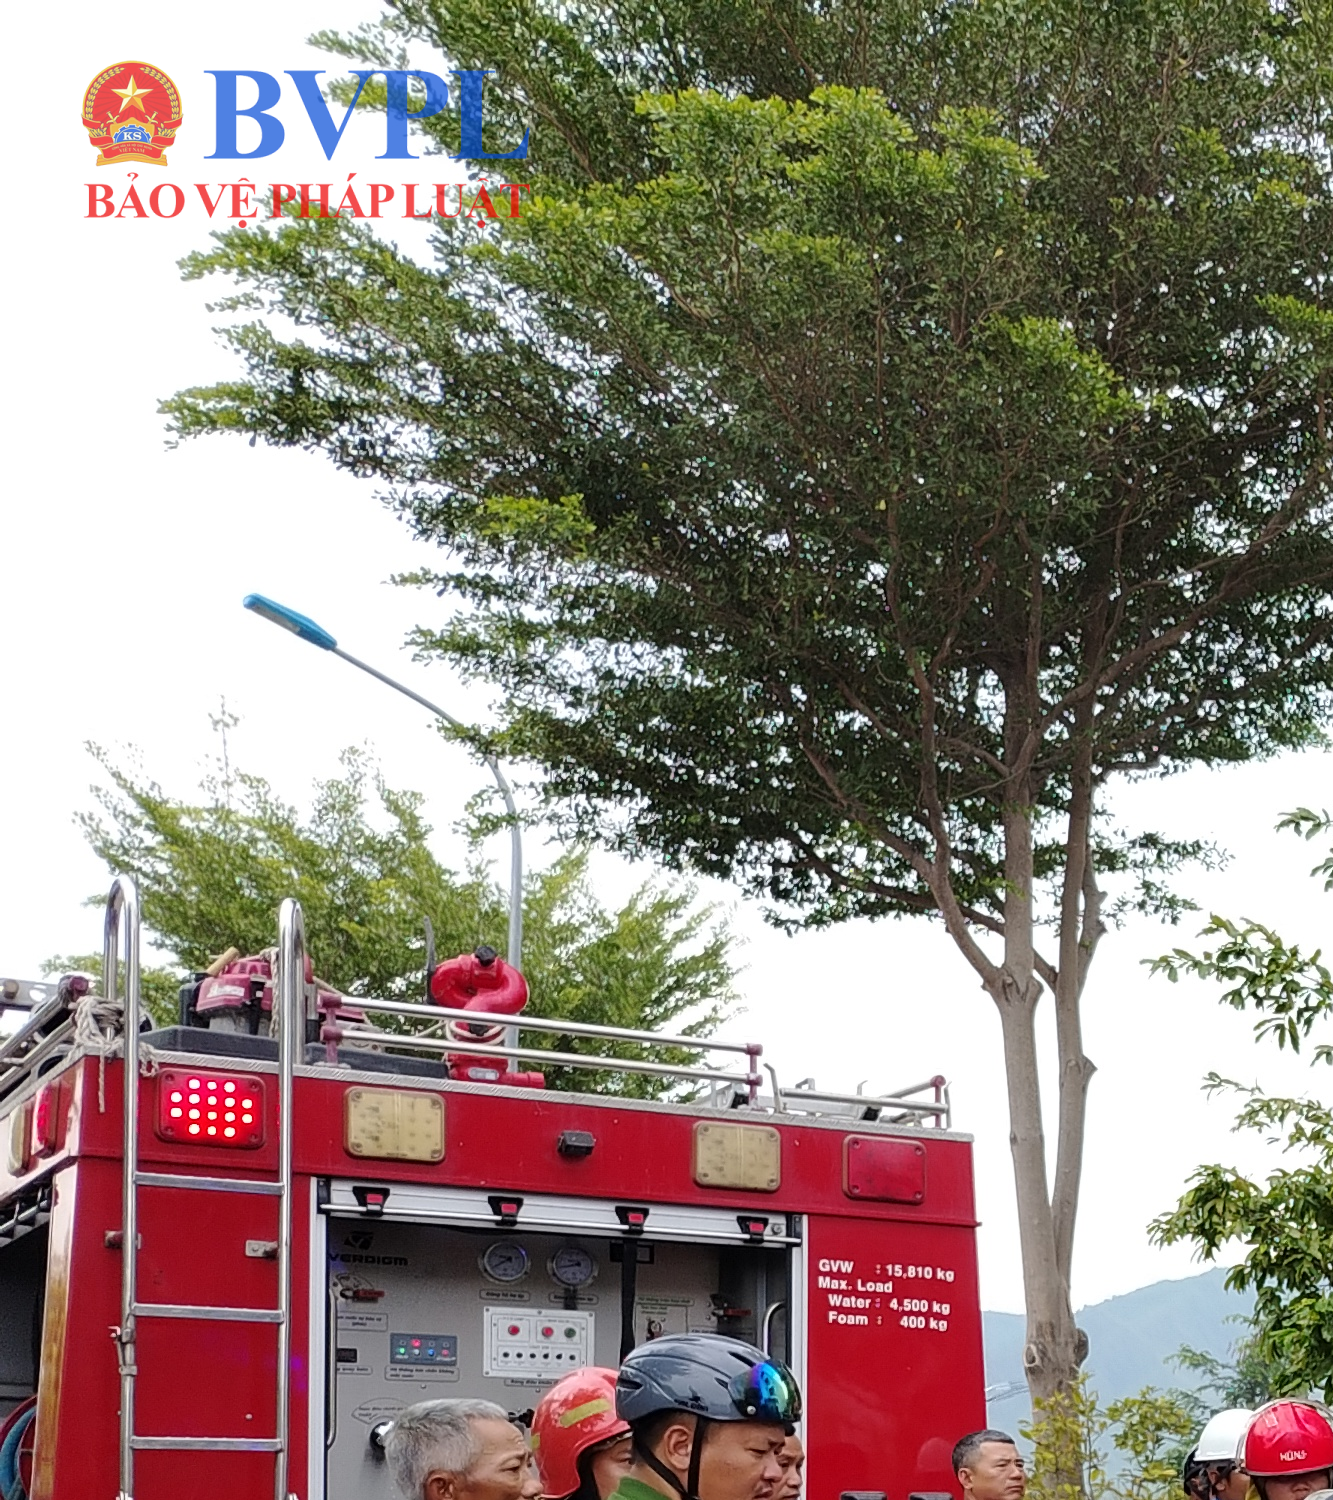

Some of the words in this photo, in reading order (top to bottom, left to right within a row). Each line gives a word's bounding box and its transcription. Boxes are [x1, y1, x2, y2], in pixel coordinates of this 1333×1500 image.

[818, 1259, 854, 1274] GVW
[885, 1264, 933, 1279] 15,810
[936, 1267, 955, 1282] kg
[818, 1276, 853, 1290] Max.
[857, 1279, 893, 1293] Load
[828, 1294, 871, 1309] Water
[889, 1298, 929, 1312] 4,500
[932, 1301, 951, 1316] kg
[828, 1311, 868, 1326] Foam
[900, 1315, 926, 1329] 400
[929, 1317, 948, 1332] kg
